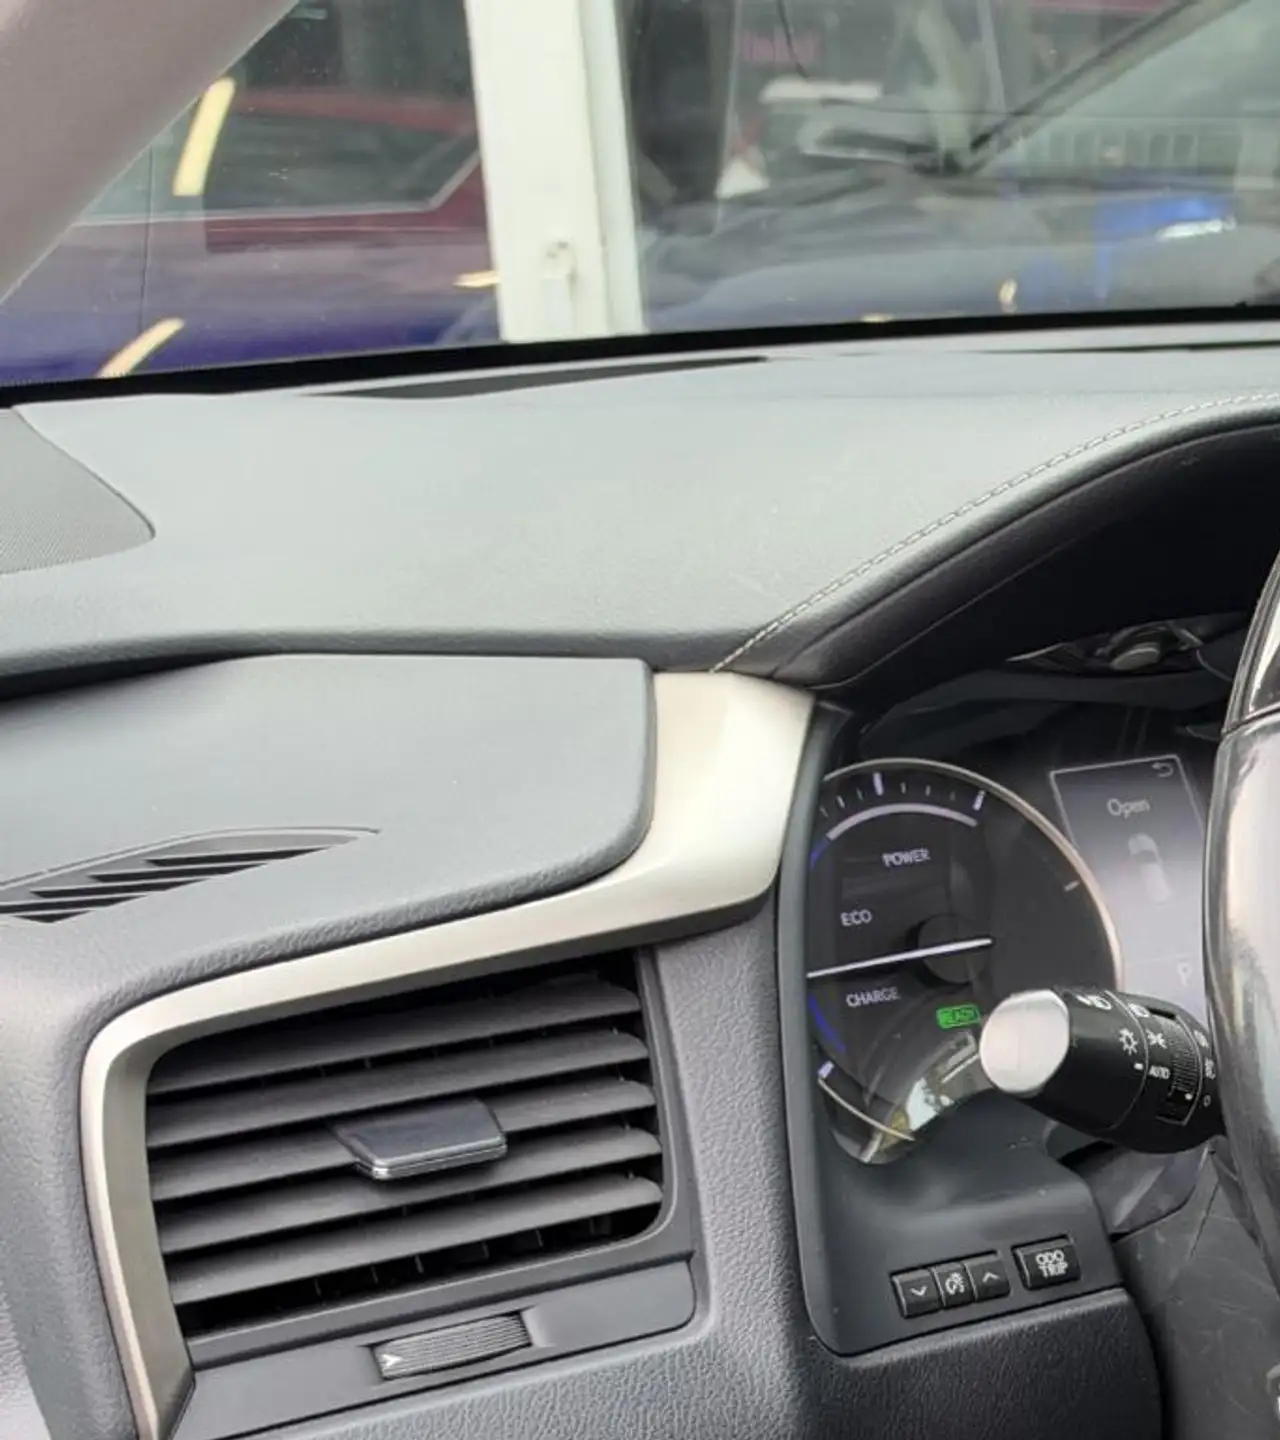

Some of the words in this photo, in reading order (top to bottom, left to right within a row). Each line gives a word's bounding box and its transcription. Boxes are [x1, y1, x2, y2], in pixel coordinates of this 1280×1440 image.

[1107, 798, 1150, 820] Open
[882, 848, 931, 868] POWER
[840, 908, 873, 927] ECO
[846, 986, 900, 1008] CHARGE
[1035, 1249, 1065, 1265] ODO
[1038, 1260, 1069, 1278] TRIP
